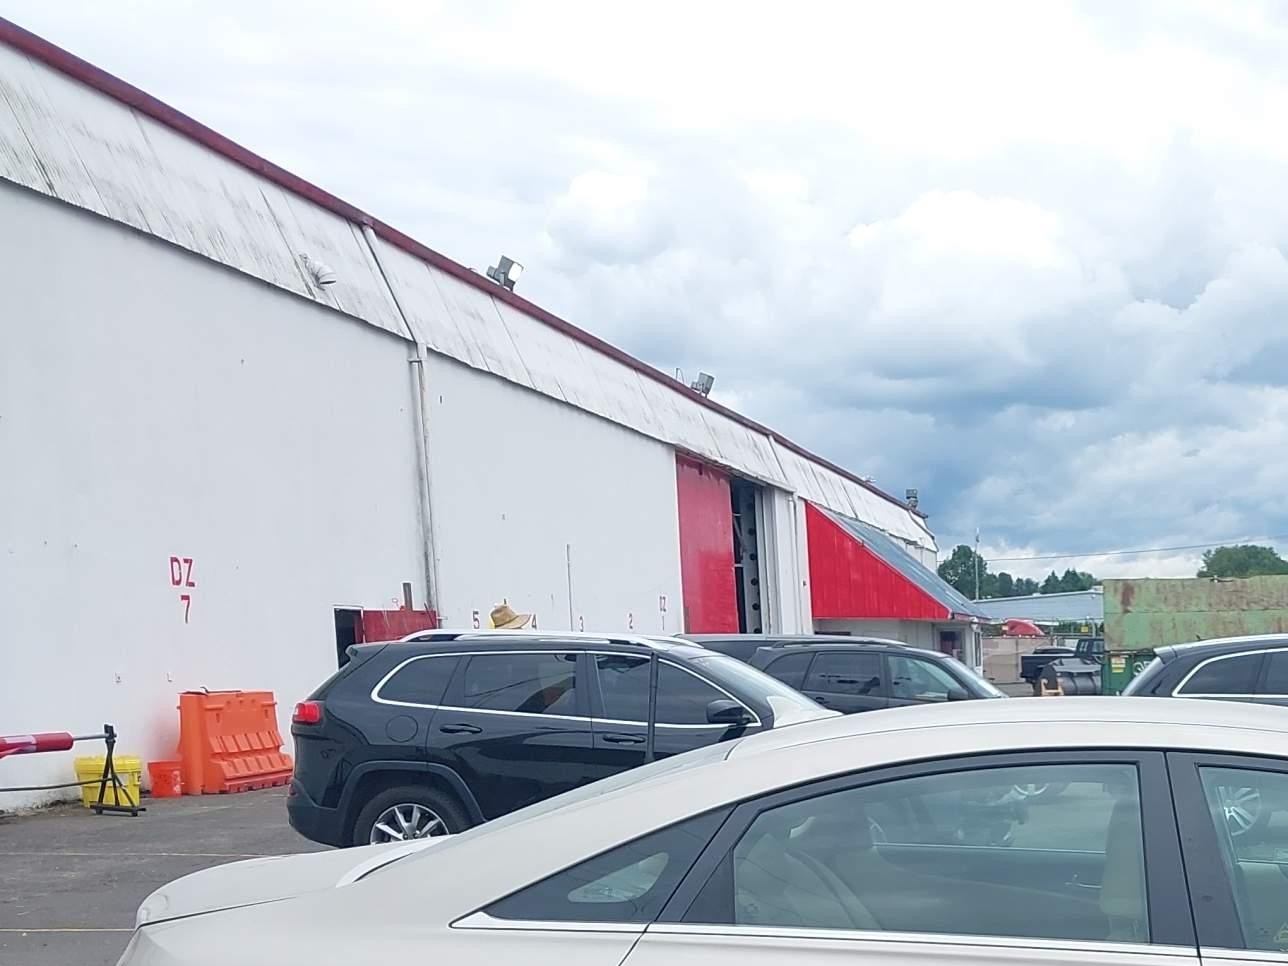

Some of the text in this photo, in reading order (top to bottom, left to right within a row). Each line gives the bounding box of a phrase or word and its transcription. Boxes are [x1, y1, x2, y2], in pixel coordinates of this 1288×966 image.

[169, 556, 196, 588] DZ
[180, 594, 191, 625] 7
[472, 610, 480, 630] 5
[531, 613, 537, 630] 4
[578, 615, 584, 633] 3
[628, 612, 634, 630] 2
